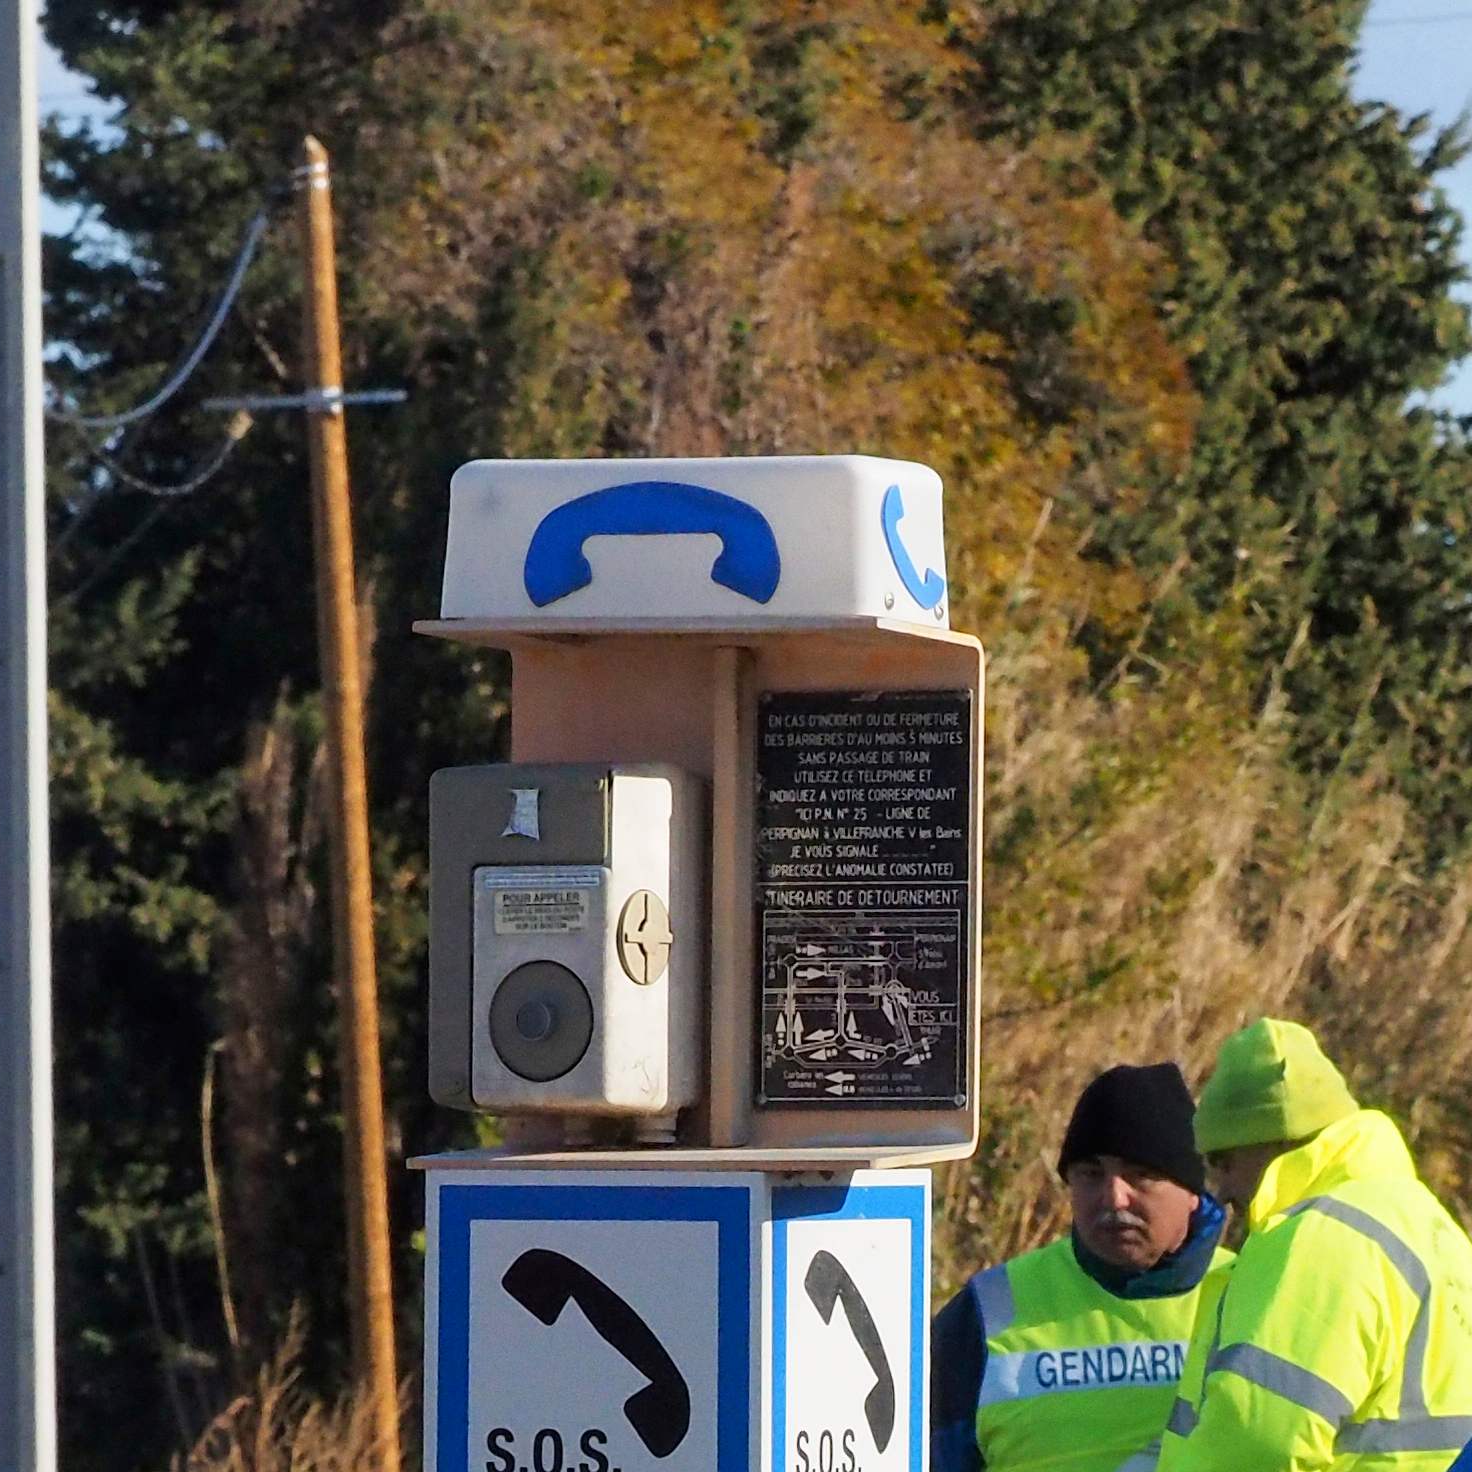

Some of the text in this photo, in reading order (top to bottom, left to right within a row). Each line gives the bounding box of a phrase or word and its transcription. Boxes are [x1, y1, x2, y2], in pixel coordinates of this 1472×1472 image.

[768, 714, 782, 728] EN
[785, 714, 805, 728] CAS
[866, 713, 880, 727] OU
[884, 713, 896, 727] DE
[900, 712, 959, 726] FERMETURE
[764, 733, 785, 747] DES
[787, 733, 844, 747] BARRIERES
[847, 732, 872, 746] D'AU
[875, 732, 907, 746] MOINS
[919, 731, 963, 745] MINUTES
[798, 750, 930, 765] SANS PASSAGE DE TRAIN
[794, 768, 933, 784] UTILISEZ CE TELEPHONE ET
[769, 787, 957, 803] INDIQUEZ A VOTRE CORRESPONDANT
[853, 807, 867, 821] 25
[885, 806, 914, 820] LIGNE
[917, 806, 931, 820] DE
[761, 826, 820, 841] PERPIGNAN
[832, 826, 905, 840] VILLEFRANCHE
[790, 844, 878, 859] JE VOUS SIGNALE
[825, 863, 887, 877] L'ANOMALIE
[889, 862, 954, 877] CONSTATEE)
[837, 889, 853, 906] DE
[857, 888, 959, 906] DETOURNEMENT
[913, 990, 940, 1003] VOUS
